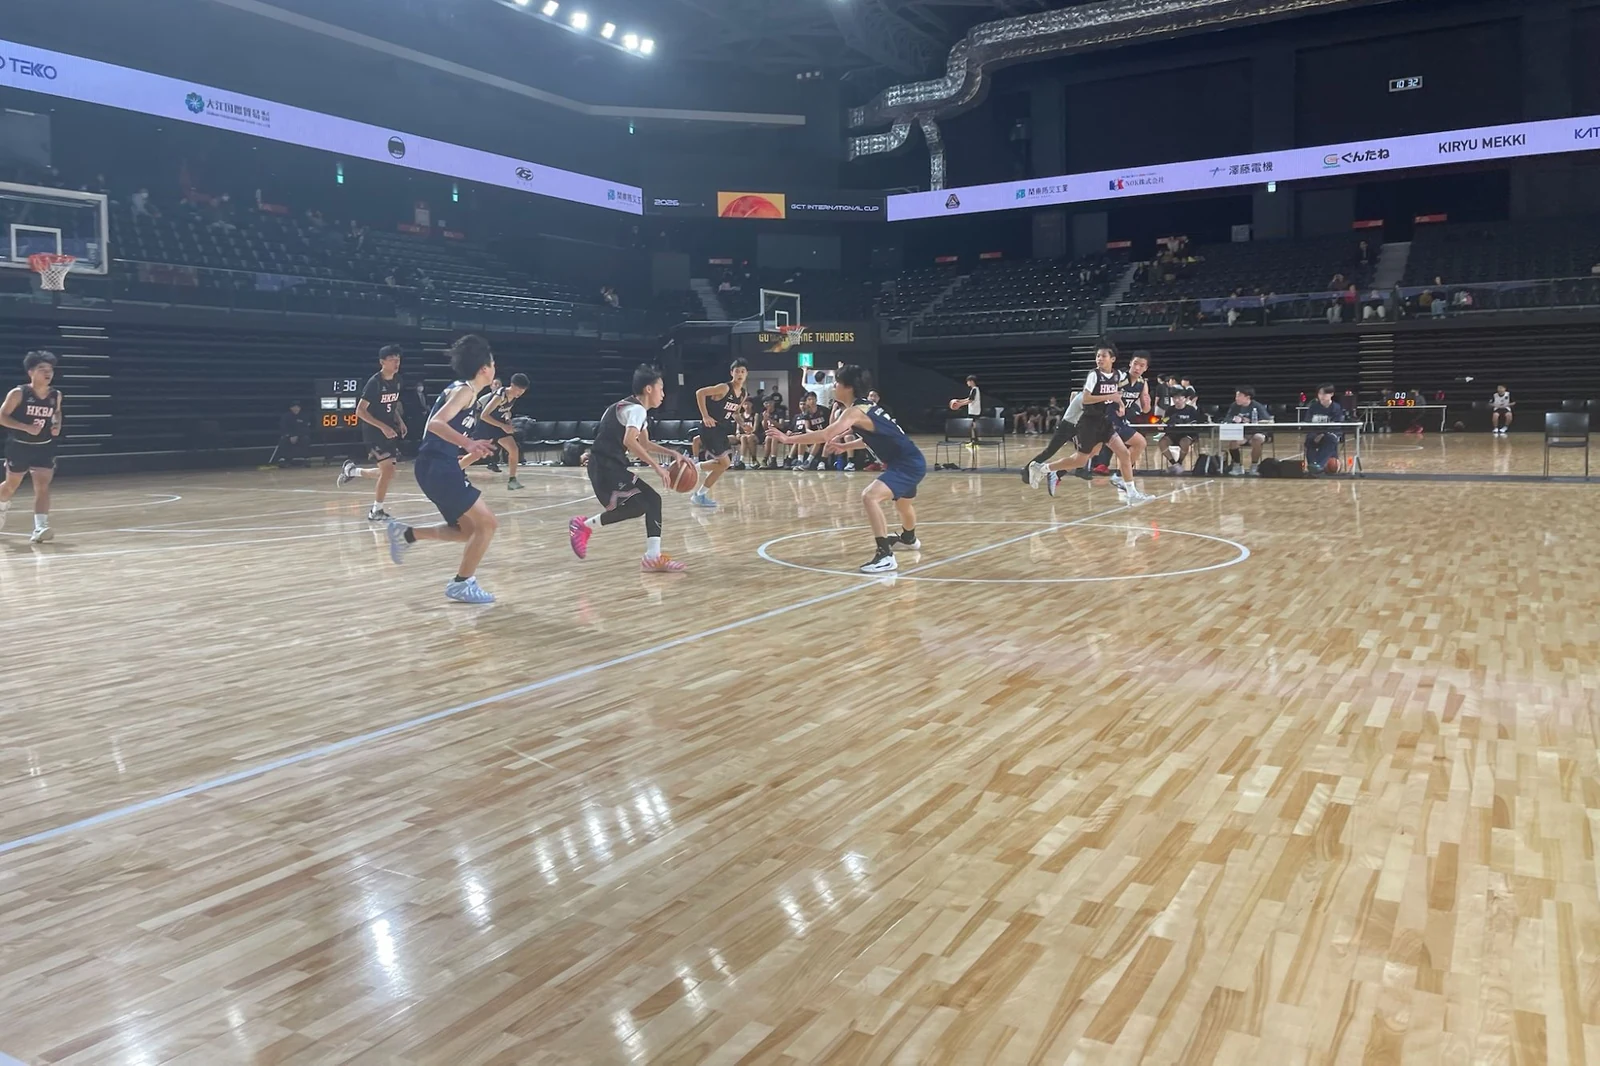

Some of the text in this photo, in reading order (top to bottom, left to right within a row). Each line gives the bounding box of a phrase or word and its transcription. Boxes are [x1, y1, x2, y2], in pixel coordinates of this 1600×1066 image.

[9, 57, 57, 80] TEKKO
[1438, 133, 1526, 154] KIRYU MEKKI
[1341, 148, 1390, 163] ぐんたね
[807, 204, 863, 212] INTERNATIONAL
[815, 332, 855, 342] THUNDERS
[333, 379, 357, 392] 1:38
[386, 403, 392, 413] 5
[322, 414, 358, 427] 68 49
